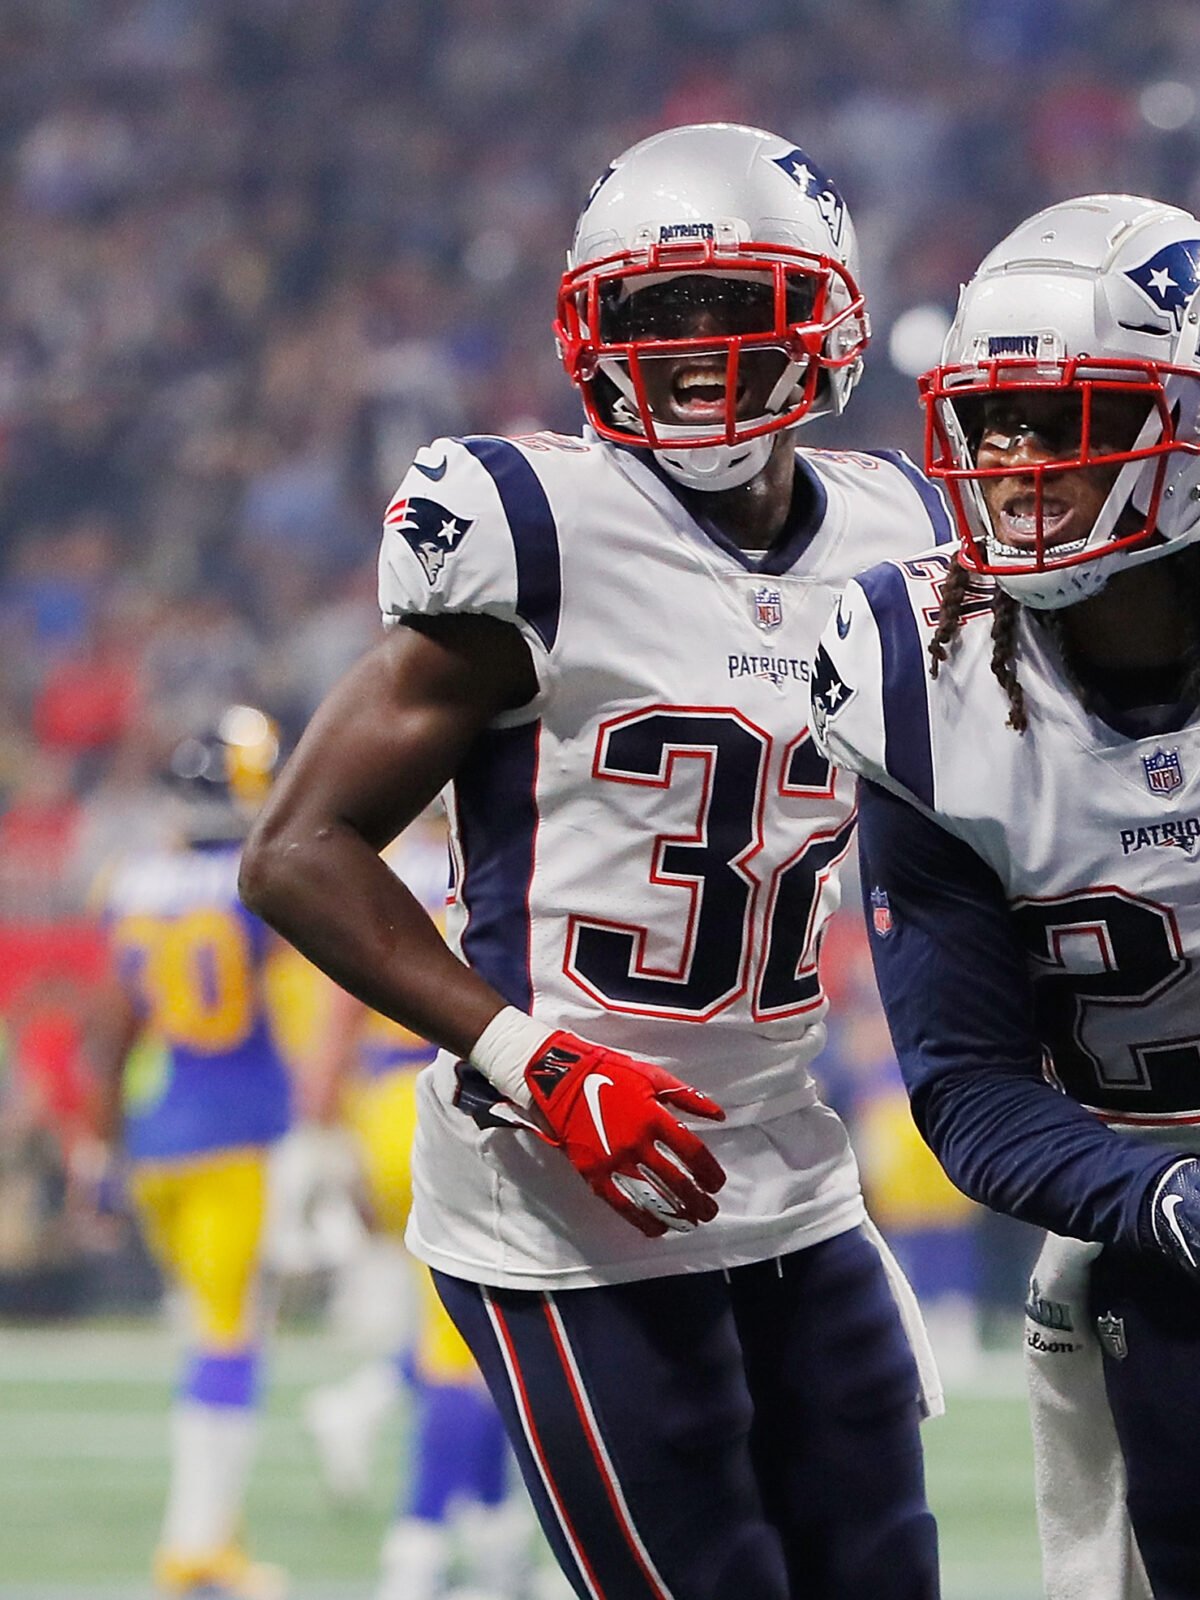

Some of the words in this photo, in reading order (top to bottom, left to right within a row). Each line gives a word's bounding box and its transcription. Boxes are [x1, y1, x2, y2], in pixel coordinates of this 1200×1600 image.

[660, 223, 714, 243] PATRIOTS
[727, 655, 811, 683] PATRIOTS
[1149, 768, 1181, 790] NFL
[563, 703, 858, 1023] 32
